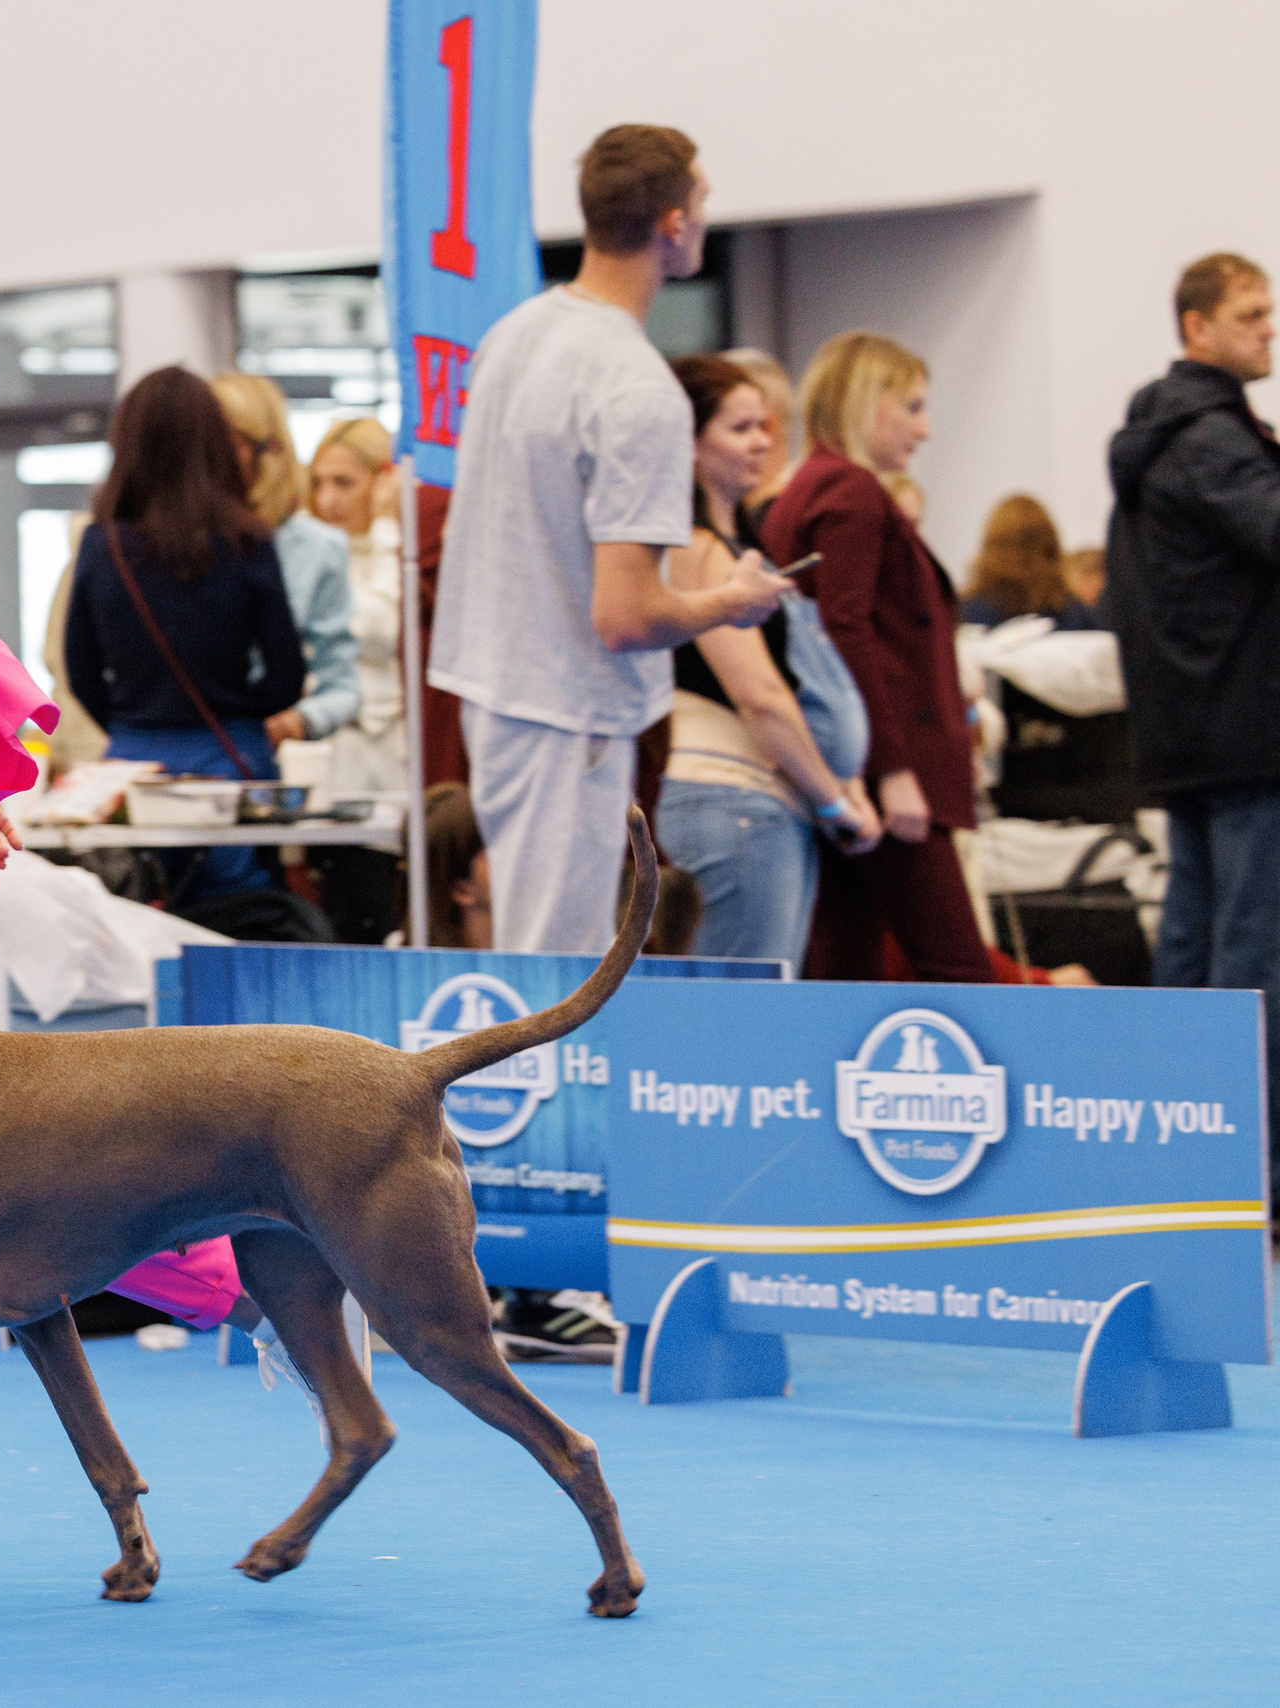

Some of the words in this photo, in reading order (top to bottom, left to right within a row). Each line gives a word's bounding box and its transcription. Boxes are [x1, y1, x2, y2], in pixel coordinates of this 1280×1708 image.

[438, 16, 476, 279] 1
[629, 1069, 741, 1128] Happy
[750, 1078, 821, 1129] pet.
[855, 1079, 987, 1124] Farmina
[1023, 1083, 1144, 1143] Happy
[1152, 1100, 1236, 1145] you.
[728, 1271, 839, 1310] Nutrition
[843, 1277, 938, 1320] System
[942, 1283, 981, 1319] for
